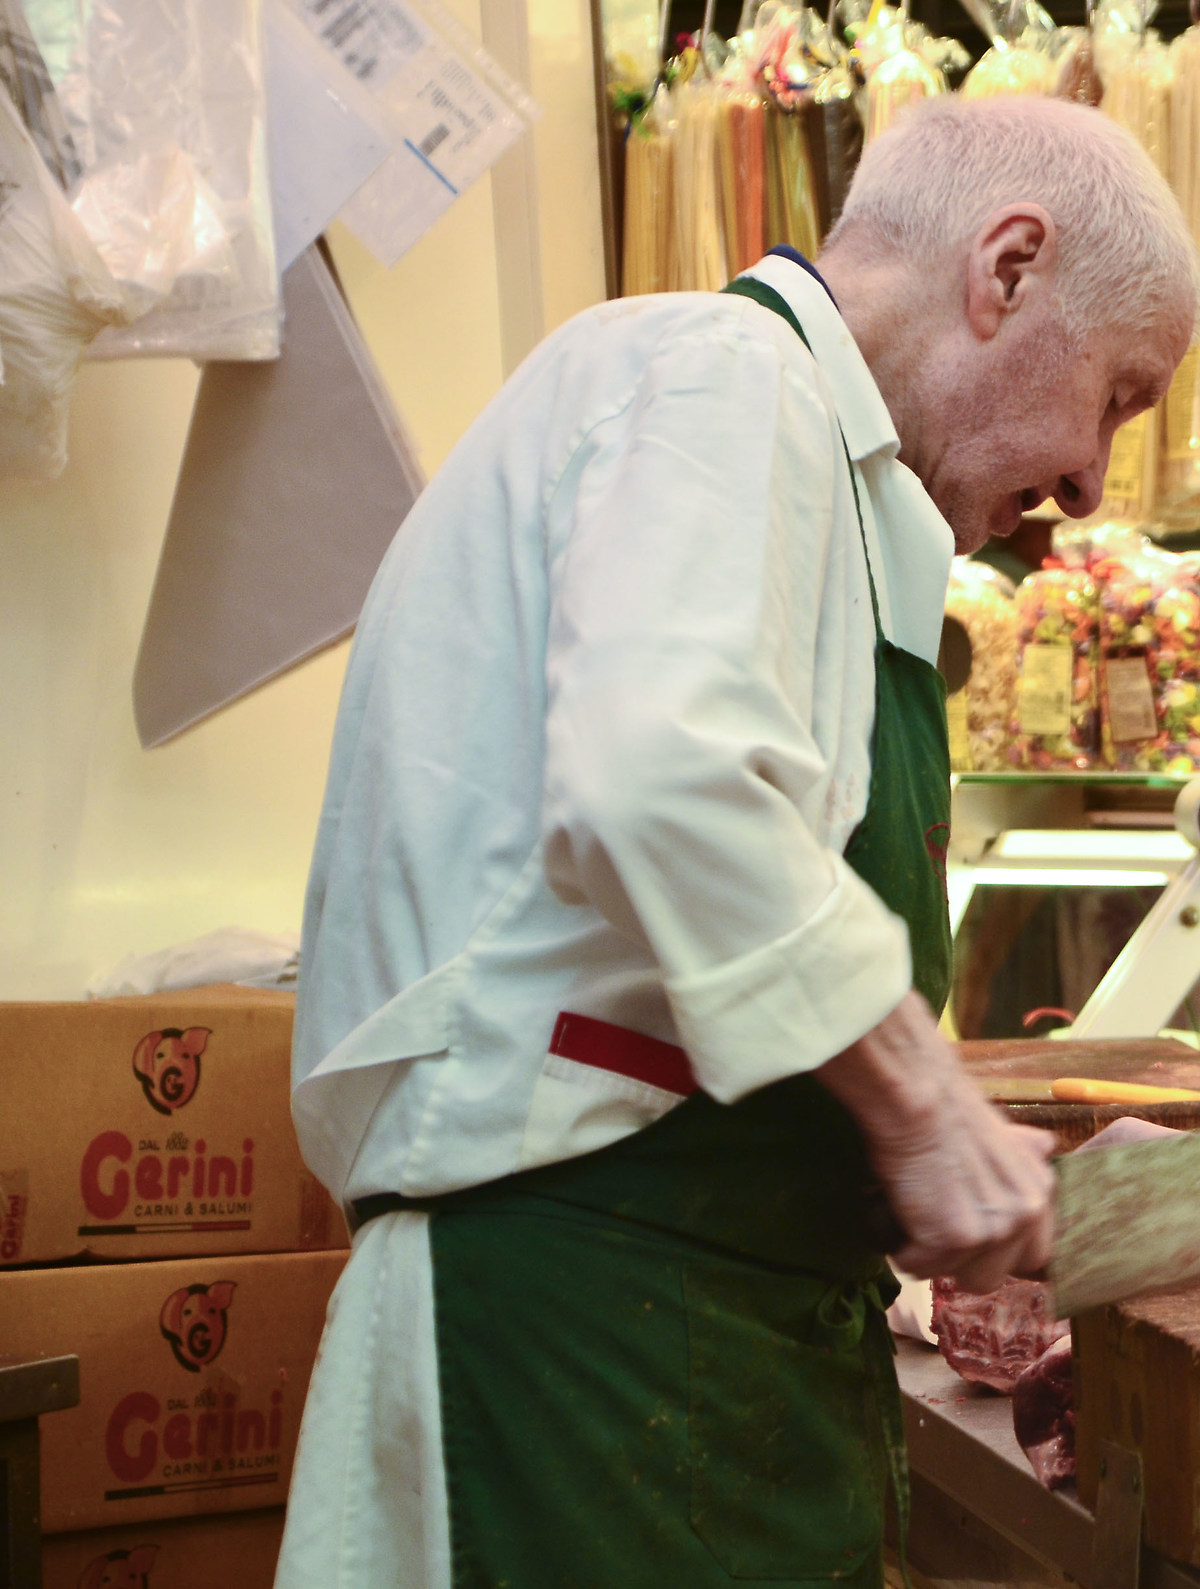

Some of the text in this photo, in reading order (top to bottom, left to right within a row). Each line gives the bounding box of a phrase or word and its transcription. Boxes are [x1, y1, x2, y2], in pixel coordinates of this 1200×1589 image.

[138, 1139, 160, 1150] DAL
[80, 1130, 255, 1220] Gerini
[134, 1202, 252, 1217] CARNI & SALUMI
[105, 1390, 283, 1482] Gerini
[163, 1462, 207, 1477] CARNI
[229, 1455, 280, 1470] SALUMI
